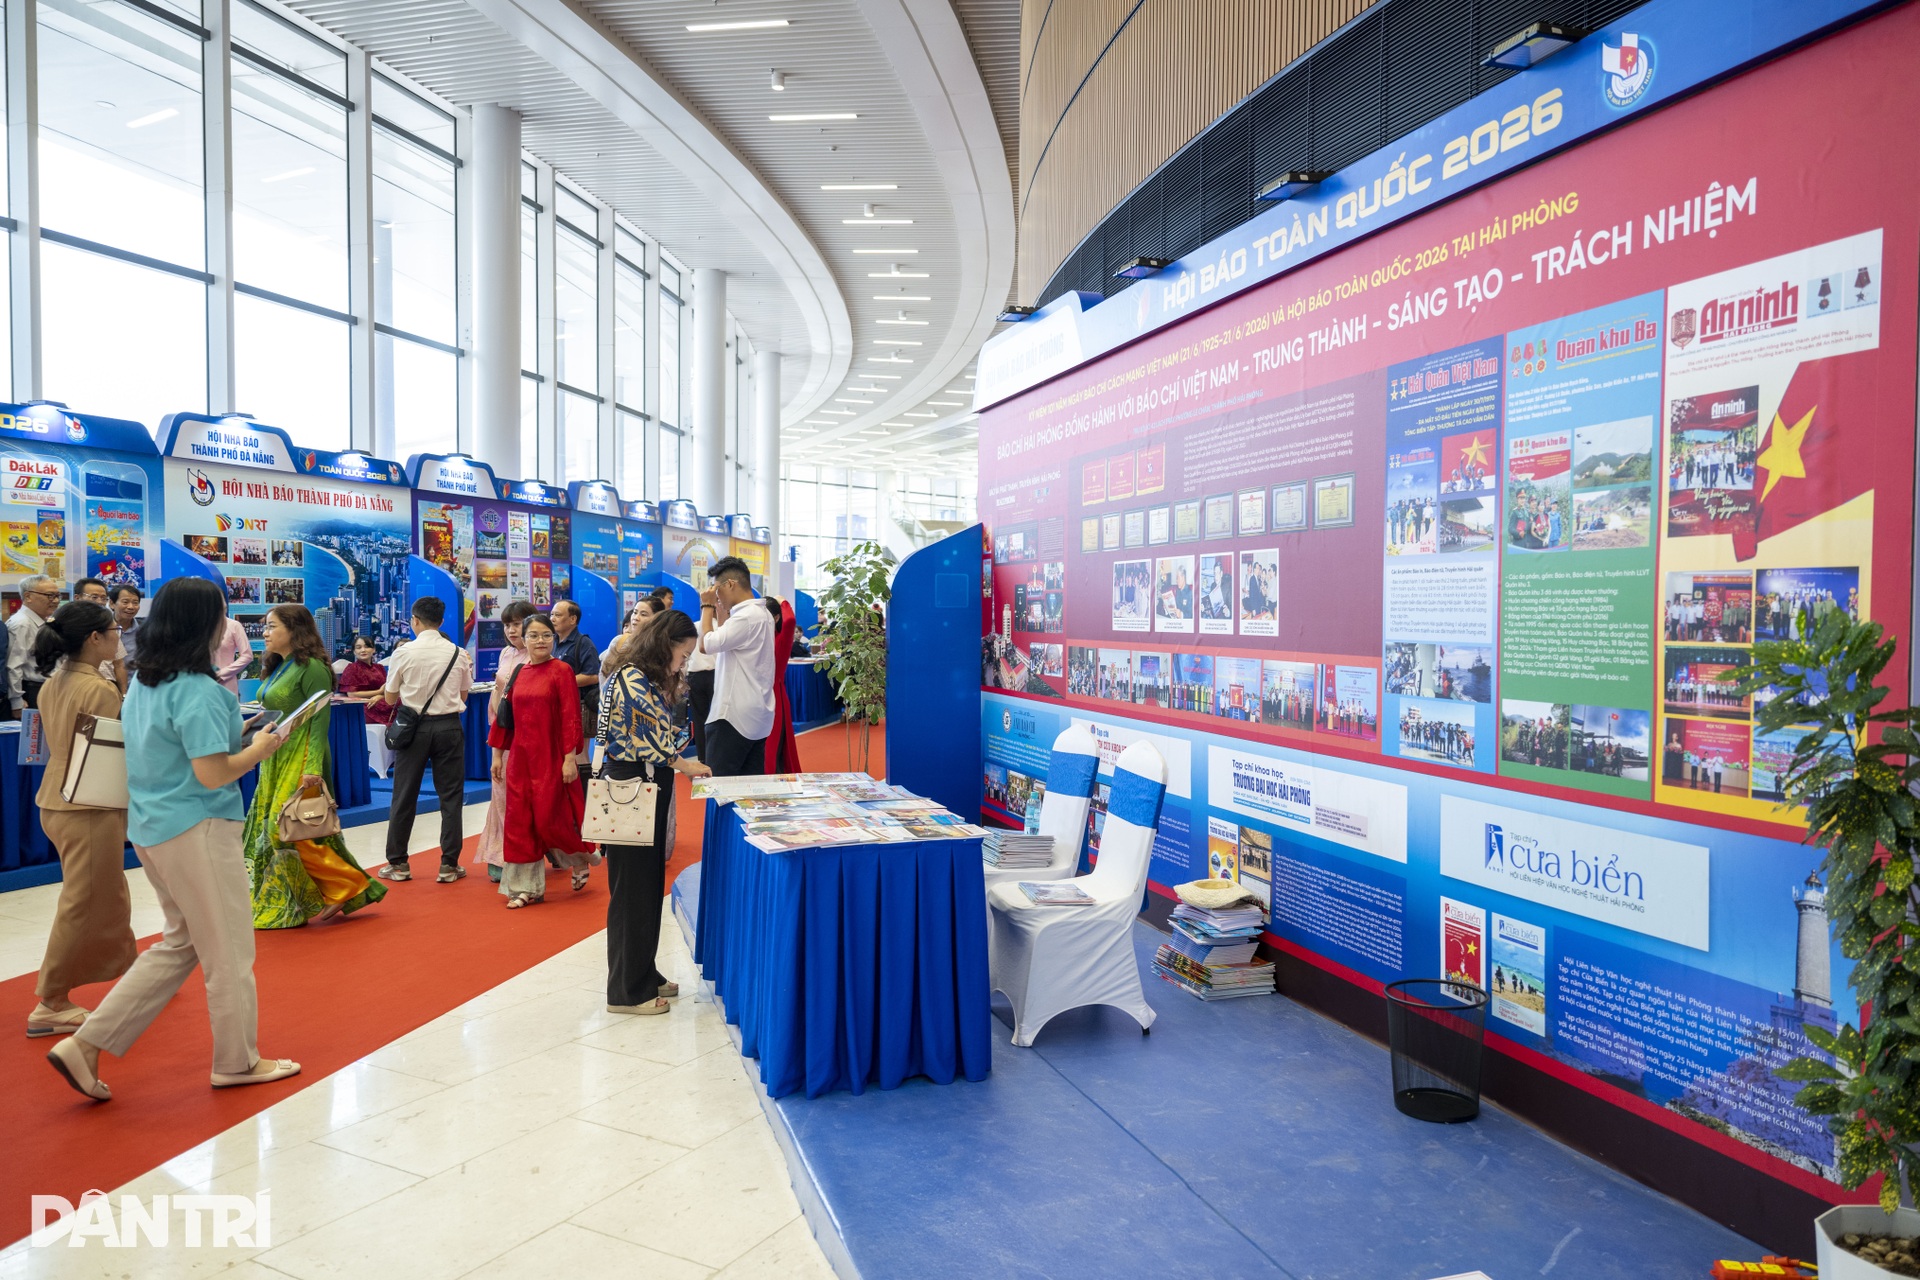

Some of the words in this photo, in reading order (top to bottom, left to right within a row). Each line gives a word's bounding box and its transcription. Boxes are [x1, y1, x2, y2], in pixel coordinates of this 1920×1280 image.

[1644, 68, 1653, 84] NAM
[1163, 271, 1194, 311] HỘI
[1200, 247, 1246, 294] BÁO
[1253, 206, 1328, 267] TOÀN
[1336, 151, 1432, 230] QUỐC
[1442, 88, 1562, 180] 2026
[1068, 391, 1083, 408] NGÀY
[1084, 386, 1096, 401] BÁO
[1097, 381, 1107, 395] CHÍ
[1107, 374, 1125, 392] CÁCH
[1125, 364, 1145, 385] MẠNG
[1146, 357, 1161, 376] VIỆT
[1162, 352, 1179, 367] NAM
[1272, 309, 1285, 325] VÀ
[1287, 300, 1306, 321] HỘI
[1308, 288, 1332, 313] BÁO
[1335, 275, 1368, 303] TOÀN
[1371, 255, 1412, 287] QUỐC
[1414, 243, 1448, 272] 2026
[1452, 232, 1475, 259] TẠI
[1479, 216, 1507, 247] HẢI
[1511, 192, 1579, 235] PHÒNG
[1700, 298, 1735, 337] An
[1738, 281, 1799, 328] ninh
[997, 443, 1010, 460] BÁO
[1011, 439, 1023, 456] CHÍ
[1024, 432, 1036, 453] HẢI
[1037, 424, 1063, 447] PHÒNG
[1065, 414, 1090, 438] ĐỒNG
[1092, 405, 1116, 429] HÀNH
[1118, 394, 1134, 420] VỚI
[1136, 387, 1158, 414] BÁO
[1160, 376, 1180, 405] CHÍ
[1182, 367, 1207, 400] VIỆT
[1210, 360, 1238, 389] NAM
[1253, 337, 1304, 374] TRUNG
[1308, 314, 1367, 356] THÀNH
[1387, 287, 1448, 331] SÁNG
[1454, 268, 1503, 313] TẠO
[1531, 221, 1632, 284] TRÁCH
[1643, 177, 1757, 249] NHIỆM
[1556, 338, 1596, 363] Quân
[1600, 327, 1630, 352] khu
[1634, 319, 1657, 343] Ba
[1407, 372, 1423, 395] Hải
[1425, 368, 1449, 392] Quân
[1451, 361, 1471, 386] Việt
[1473, 357, 1498, 379] Nam
[191, 443, 219, 457] THÀNH
[221, 446, 238, 460] PHỐ
[240, 449, 251, 462] ĐÀ
[253, 450, 275, 464] NẴNG
[208, 430, 222, 444] HỘI
[243, 435, 259, 448] BÁO
[16, 476, 51, 490] DRT
[319, 465, 341, 475] TOÀN
[343, 466, 366, 478] QUỐC
[366, 471, 387, 481] 2026
[436, 479, 455, 490] THÀNH
[455, 481, 466, 492] PHỐ
[466, 483, 477, 493] HUẾ
[440, 467, 450, 479] HỘI
[463, 471, 473, 481] BÁO
[222, 478, 243, 498] HỘI
[246, 482, 270, 499] NHÀ
[273, 484, 294, 502] BÁO
[297, 487, 330, 506] THÀNH
[333, 491, 353, 507] PHỐ
[355, 492, 367, 510] ĐÀ
[370, 493, 393, 512] NẴNG
[512, 492, 528, 501] TOÀN
[1232, 759, 1243, 771] Tạp
[1244, 762, 1254, 772] chí
[1254, 764, 1270, 776] khoa
[1271, 767, 1284, 781] học
[1233, 771, 1255, 793] TRƯỜNG
[1255, 777, 1265, 797] ĐẠI
[1266, 780, 1277, 800] HỌC
[1278, 780, 1289, 801] HẢI
[1289, 785, 1311, 806] PHÒNG
[1510, 832, 1522, 843] Tạp
[1509, 839, 1561, 879] cửa
[1571, 850, 1645, 900] biển
[1509, 871, 1519, 879] HỘI
[1519, 872, 1532, 882] LIÊN
[1532, 876, 1545, 887] HIỆP
[1546, 879, 1557, 890] VĂN
[1558, 884, 1570, 894] HỌC
[1571, 886, 1588, 899] NGHỆ
[1589, 890, 1609, 903] THUẬT
[1610, 895, 1621, 906] HẢI
[1622, 898, 1645, 913] PHÒNG
[1563, 956, 1574, 966] Hội
[1576, 960, 1589, 970] Liên
[1591, 964, 1604, 976] hiệp
[1606, 970, 1618, 980] Văn
[1620, 974, 1632, 985] học
[1635, 980, 1651, 992] nghệ
[1654, 986, 1672, 998] thuật
[1674, 992, 1686, 1003] Hải
[1688, 997, 1712, 1013] Phòng
[1714, 1006, 1737, 1020] thành
[1739, 1013, 1752, 1026] lập
[1755, 1020, 1774, 1035] ngày
